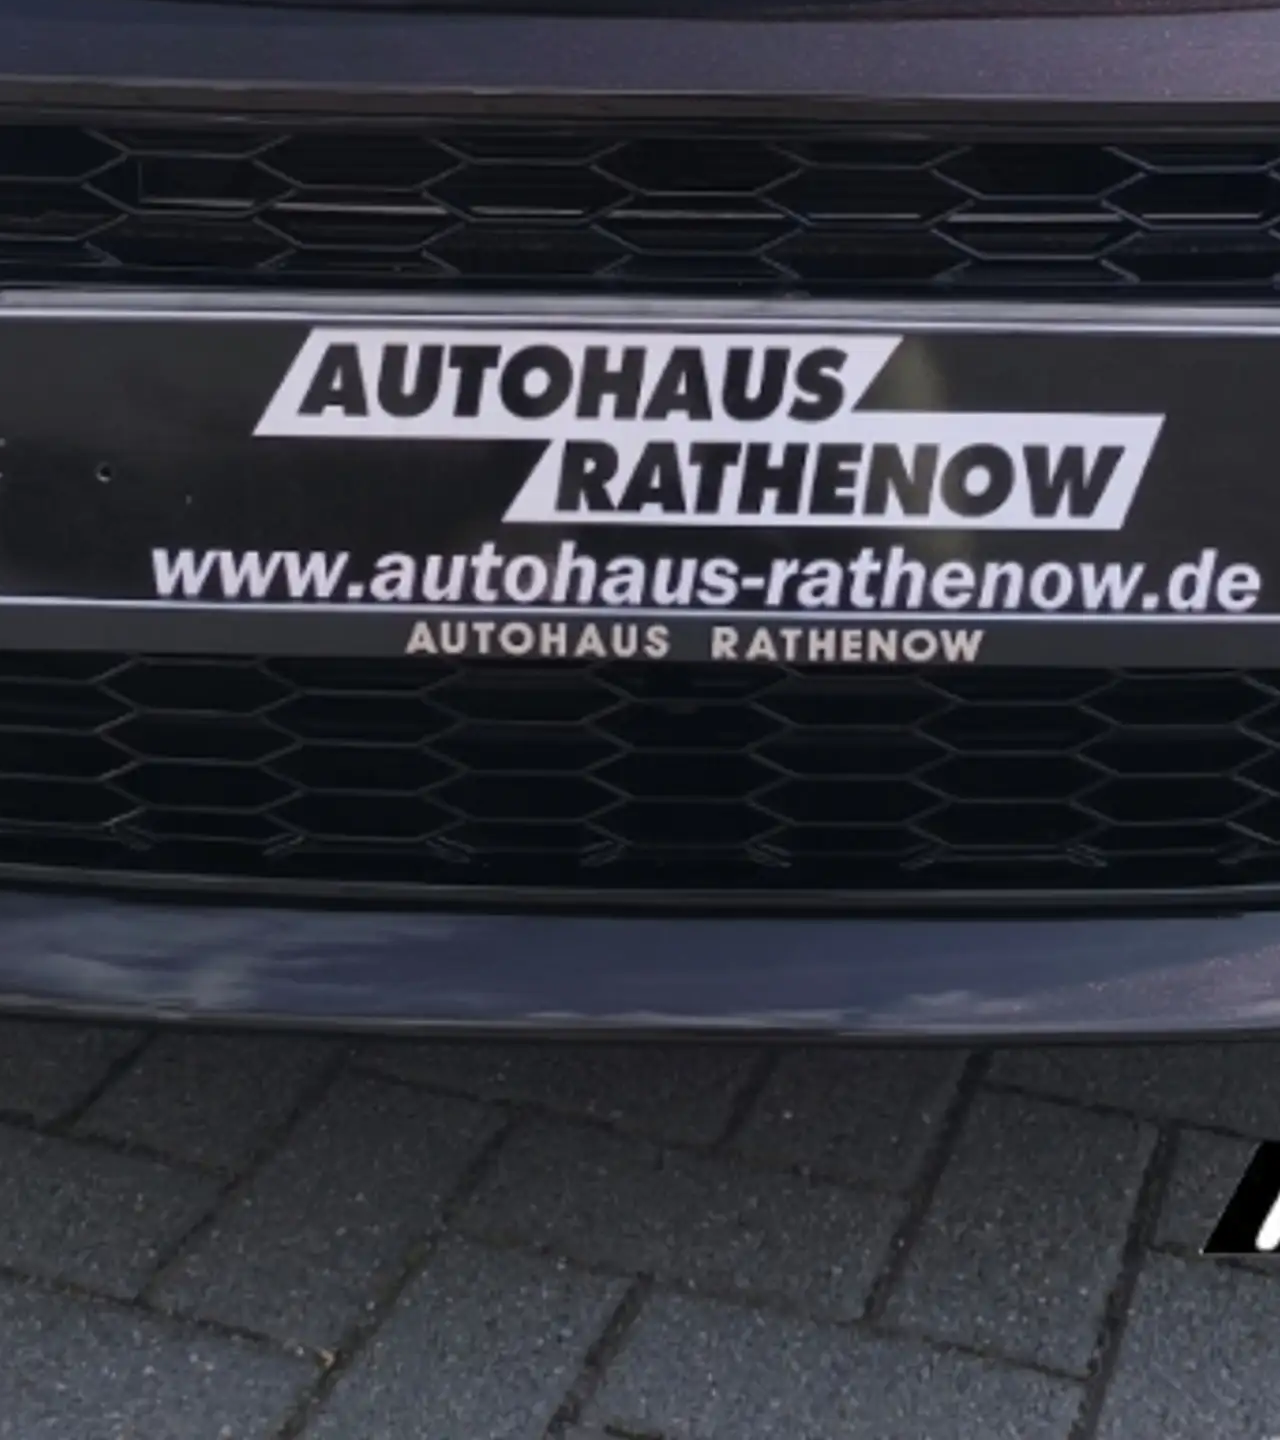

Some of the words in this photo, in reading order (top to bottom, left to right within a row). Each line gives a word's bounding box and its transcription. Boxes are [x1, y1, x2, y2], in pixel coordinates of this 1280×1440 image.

[297, 343, 849, 422] AUTOHAUS
[554, 439, 1126, 518] RATHENOW
[151, 541, 1262, 612] www.autohaus-rathenow.de
[406, 621, 670, 658] AUTOHAUS
[711, 626, 985, 662] RATHENOW
